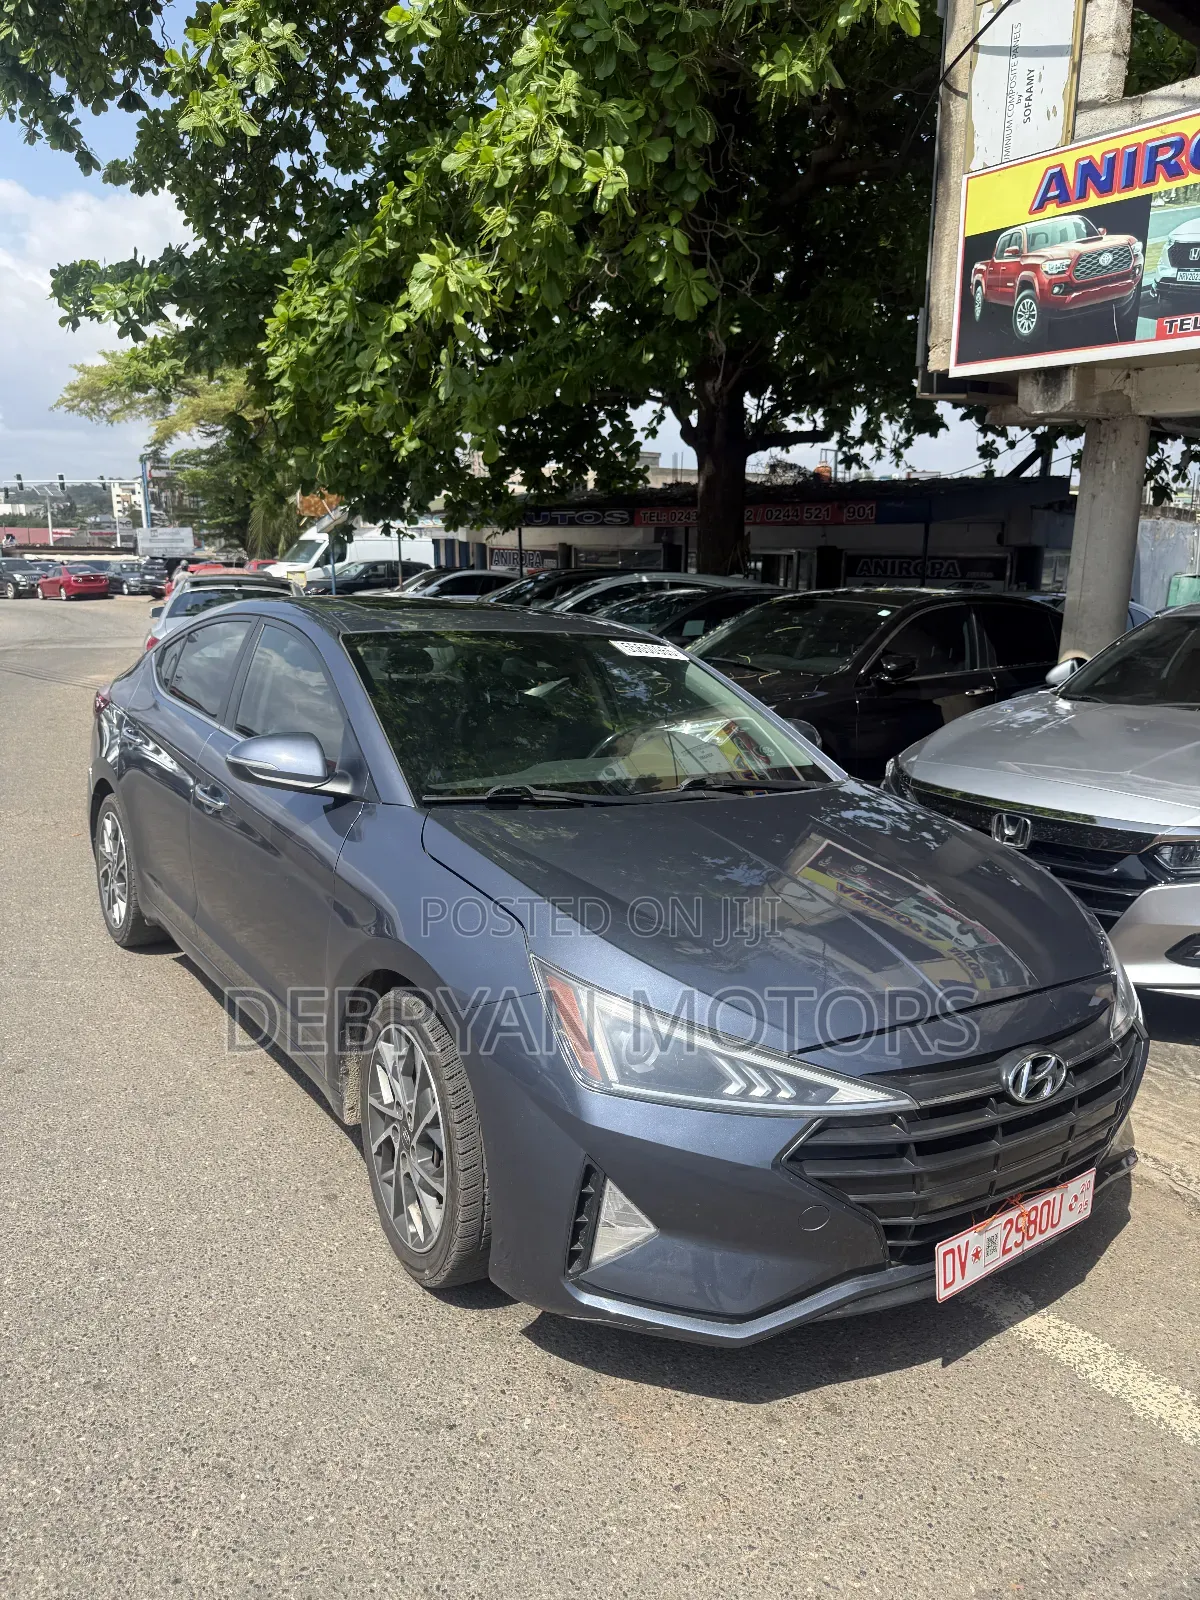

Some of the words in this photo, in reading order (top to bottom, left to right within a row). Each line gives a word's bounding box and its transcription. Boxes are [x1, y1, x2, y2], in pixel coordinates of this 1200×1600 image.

[1011, 22, 1022, 59] PANELS
[1007, 61, 1018, 117] COMPOSITE
[1015, 94, 1023, 105] by
[1023, 68, 1035, 124] SOFAAMY
[1164, 314, 1200, 335] TEL
[523, 510, 630, 526] UTOS
[640, 509, 666, 523] TEL:
[764, 507, 801, 522] 0244
[803, 505, 832, 521] 521
[845, 502, 877, 519] 901
[943, 1239, 969, 1290] DV
